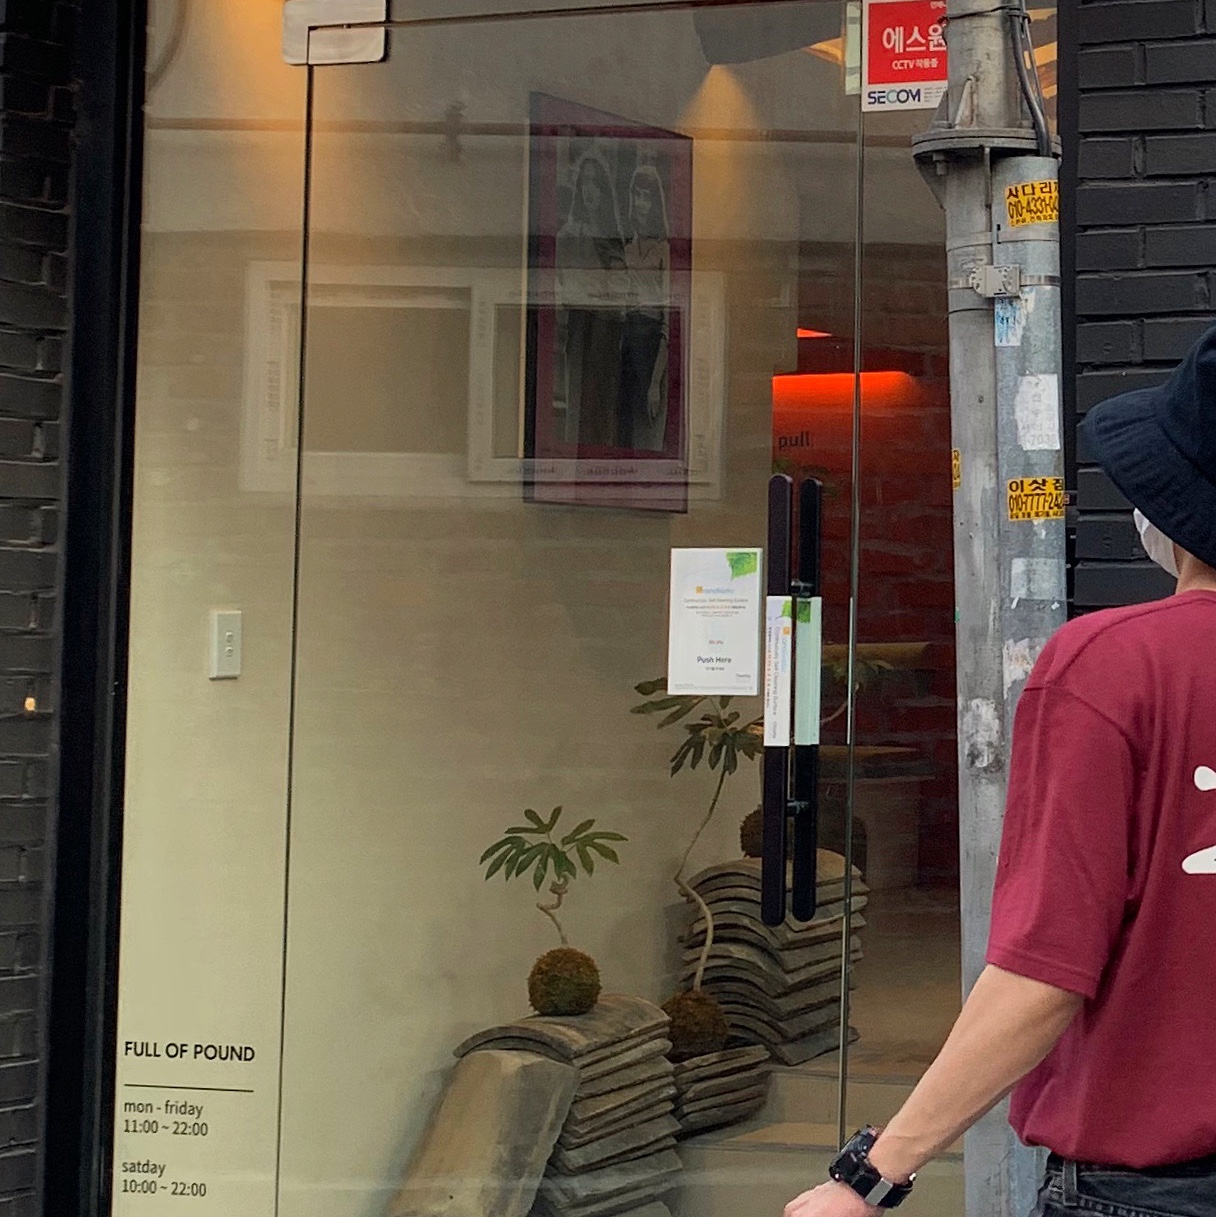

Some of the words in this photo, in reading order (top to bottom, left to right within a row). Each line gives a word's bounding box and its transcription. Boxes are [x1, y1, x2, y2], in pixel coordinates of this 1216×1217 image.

[891, 59, 915, 70] CCTV
[867, 88, 921, 105] SECOM
[778, 431, 811, 450] pull
[696, 655, 714, 664] Push
[124, 1041, 161, 1057] FULL
[165, 1042, 188, 1059] OF
[193, 1043, 256, 1061] POUND
[123, 1102, 153, 1114] mon
[165, 1100, 204, 1120] friday
[123, 1119, 159, 1134] 11:00
[172, 1121, 208, 1136] 22:00
[121, 1159, 166, 1178] satday
[122, 1179, 157, 1194] 10:00
[171, 1181, 207, 1197] 22:00
